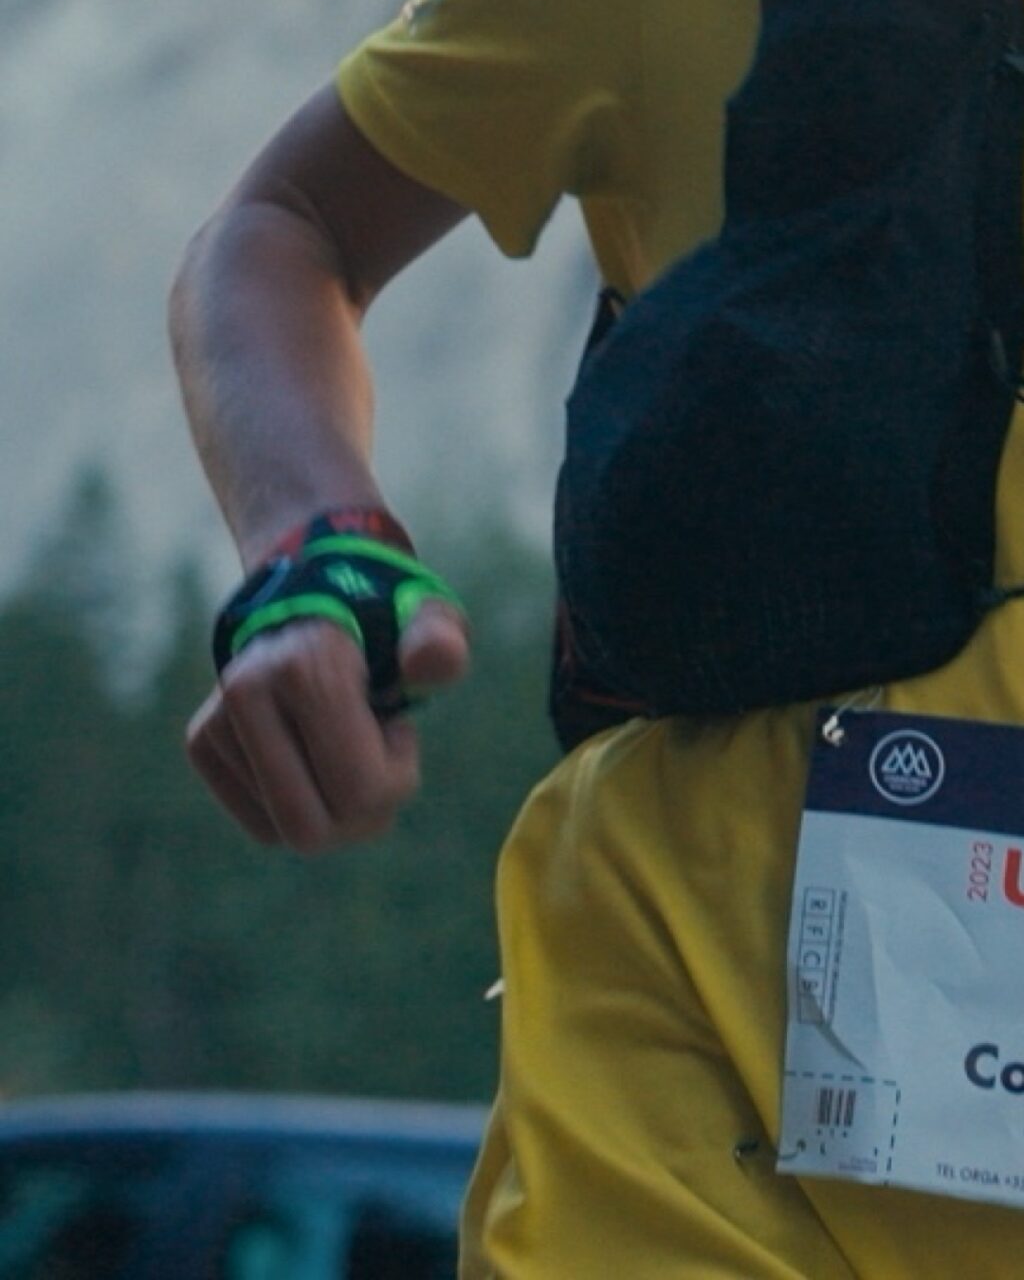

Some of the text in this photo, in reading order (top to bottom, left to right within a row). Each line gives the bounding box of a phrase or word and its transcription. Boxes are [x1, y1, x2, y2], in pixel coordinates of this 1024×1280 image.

[967, 840, 994, 903] 2023
[936, 1163, 954, 1180] TEL
[960, 1166, 999, 1185] ORGA
